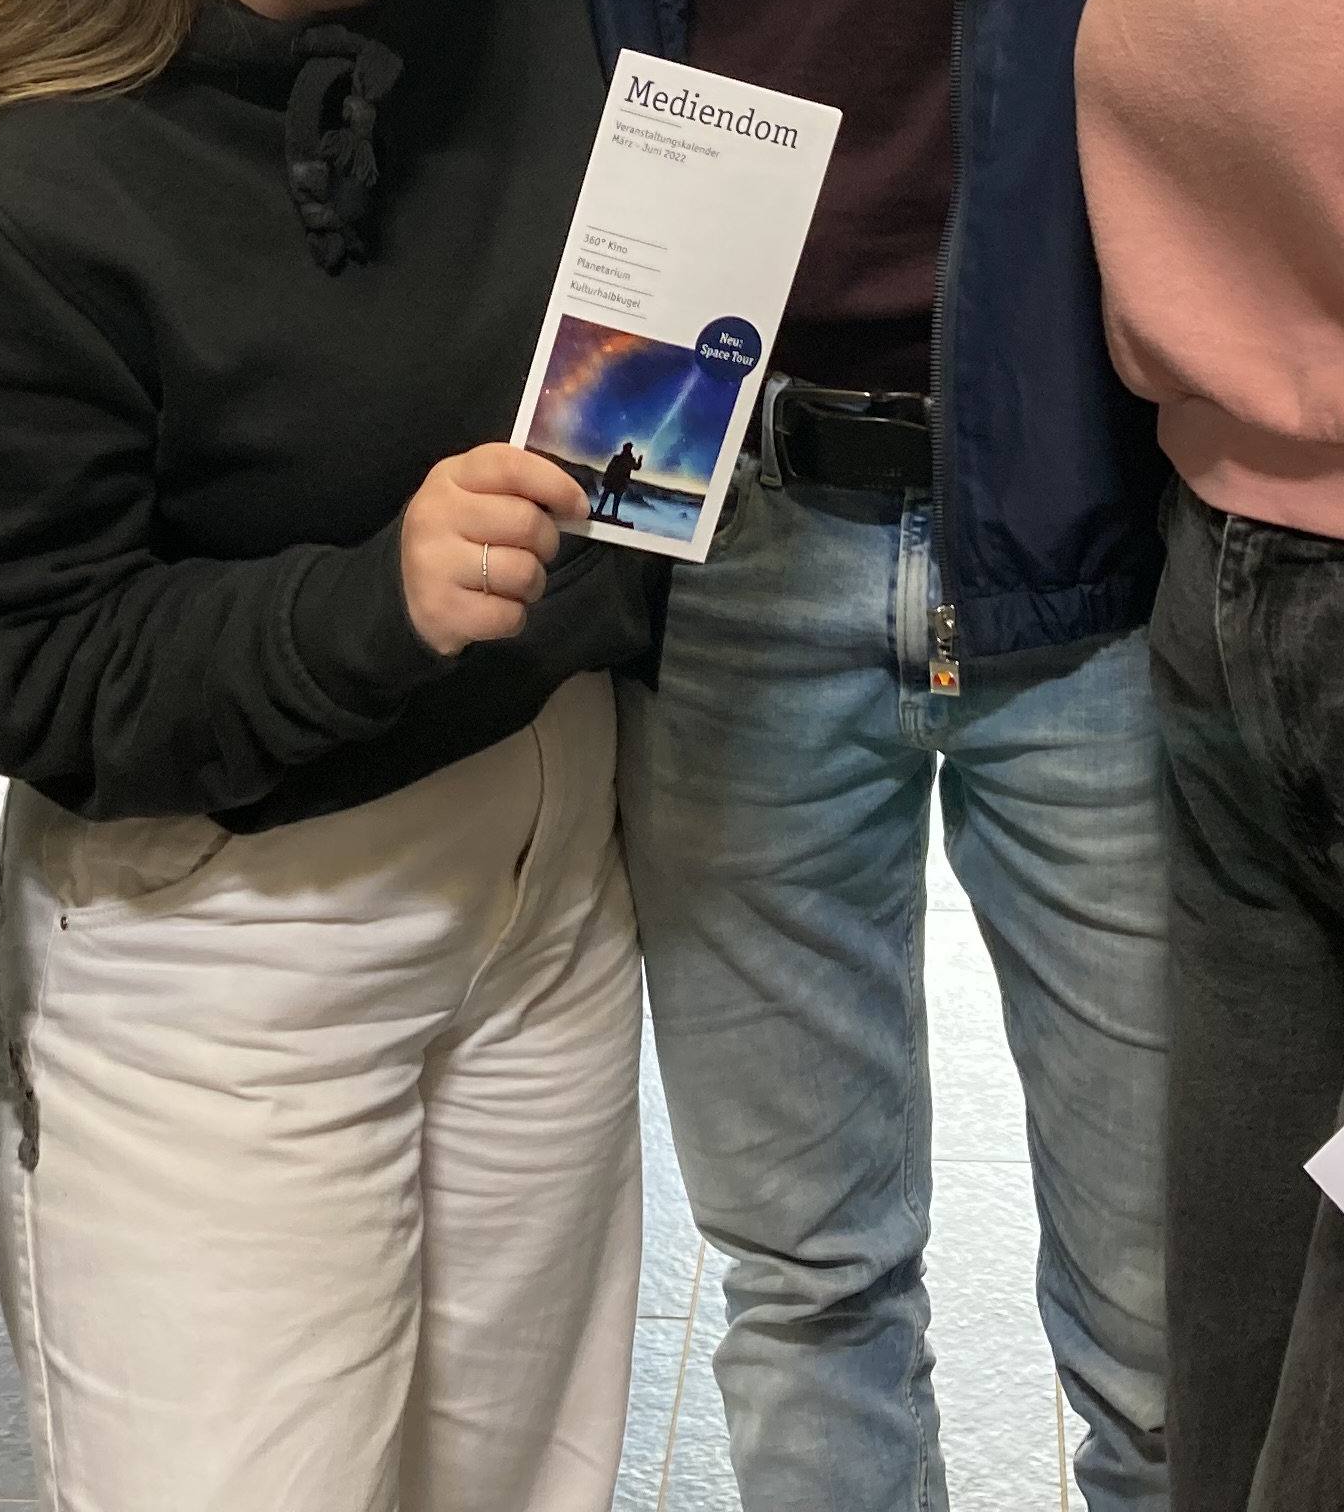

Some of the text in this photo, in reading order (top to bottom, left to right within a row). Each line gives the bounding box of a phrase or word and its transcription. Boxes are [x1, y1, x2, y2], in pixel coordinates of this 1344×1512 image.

[624, 75, 798, 149] Mediendom
[612, 134, 633, 148] März
[642, 143, 662, 156] Juni
[664, 149, 687, 163] 2022
[616, 119, 721, 158] Veranstaltungskalender
[608, 240, 628, 254] Kino
[577, 257, 631, 281] Planetarium
[570, 280, 641, 309] Kulturhalbkugel
[700, 344, 755, 367] Space Tour
